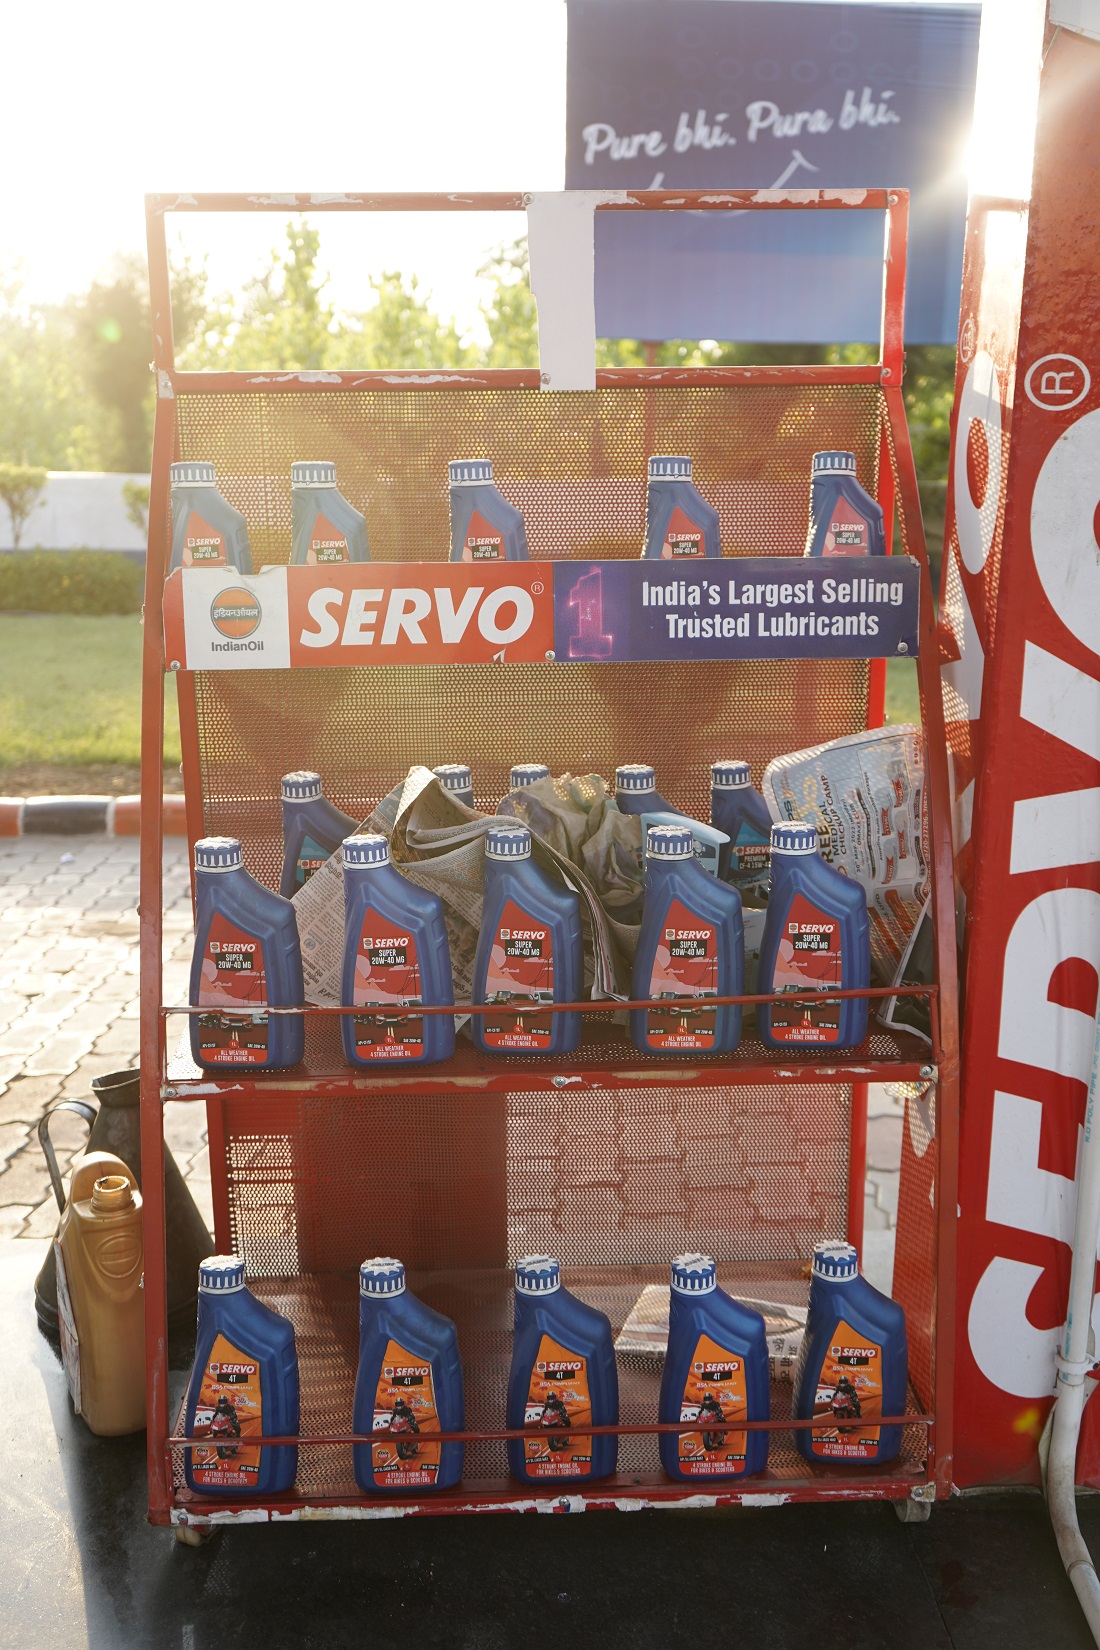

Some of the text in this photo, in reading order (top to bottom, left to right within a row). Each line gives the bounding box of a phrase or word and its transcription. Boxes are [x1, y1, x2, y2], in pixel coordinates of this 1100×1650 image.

[583, 86, 899, 165] Pure bhi. Pura bhi.
[196, 538, 220, 546] SERVO
[642, 578, 904, 607] India's Largest Selling
[300, 585, 534, 648] SERVO
[666, 611, 879, 639] Trusted Lubricants
[211, 640, 264, 652] IndianOil
[820, 774, 847, 855] CHECKUP CAMP
[819, 801, 840, 856] MEDICAL
[817, 824, 834, 864] REE
[800, 924, 833, 933] SERVO
[512, 930, 545, 940] SERVO
[677, 930, 710, 939] SERVO
[222, 943, 256, 952] SERVO
[375, 938, 408, 948] SERVO
[680, 941, 697, 949] SUPER
[225, 953, 244, 962] SUPER
[378, 949, 396, 957] SUPER
[218, 961, 241, 969] 20W-40
[372, 956, 394, 965] 20W-40
[842, 1347, 876, 1356] SERVO
[222, 1365, 254, 1373] SERVO
[548, 1362, 581, 1370] SERVO
[706, 1362, 738, 1371] SERVO
[396, 1367, 428, 1376] SERVO
